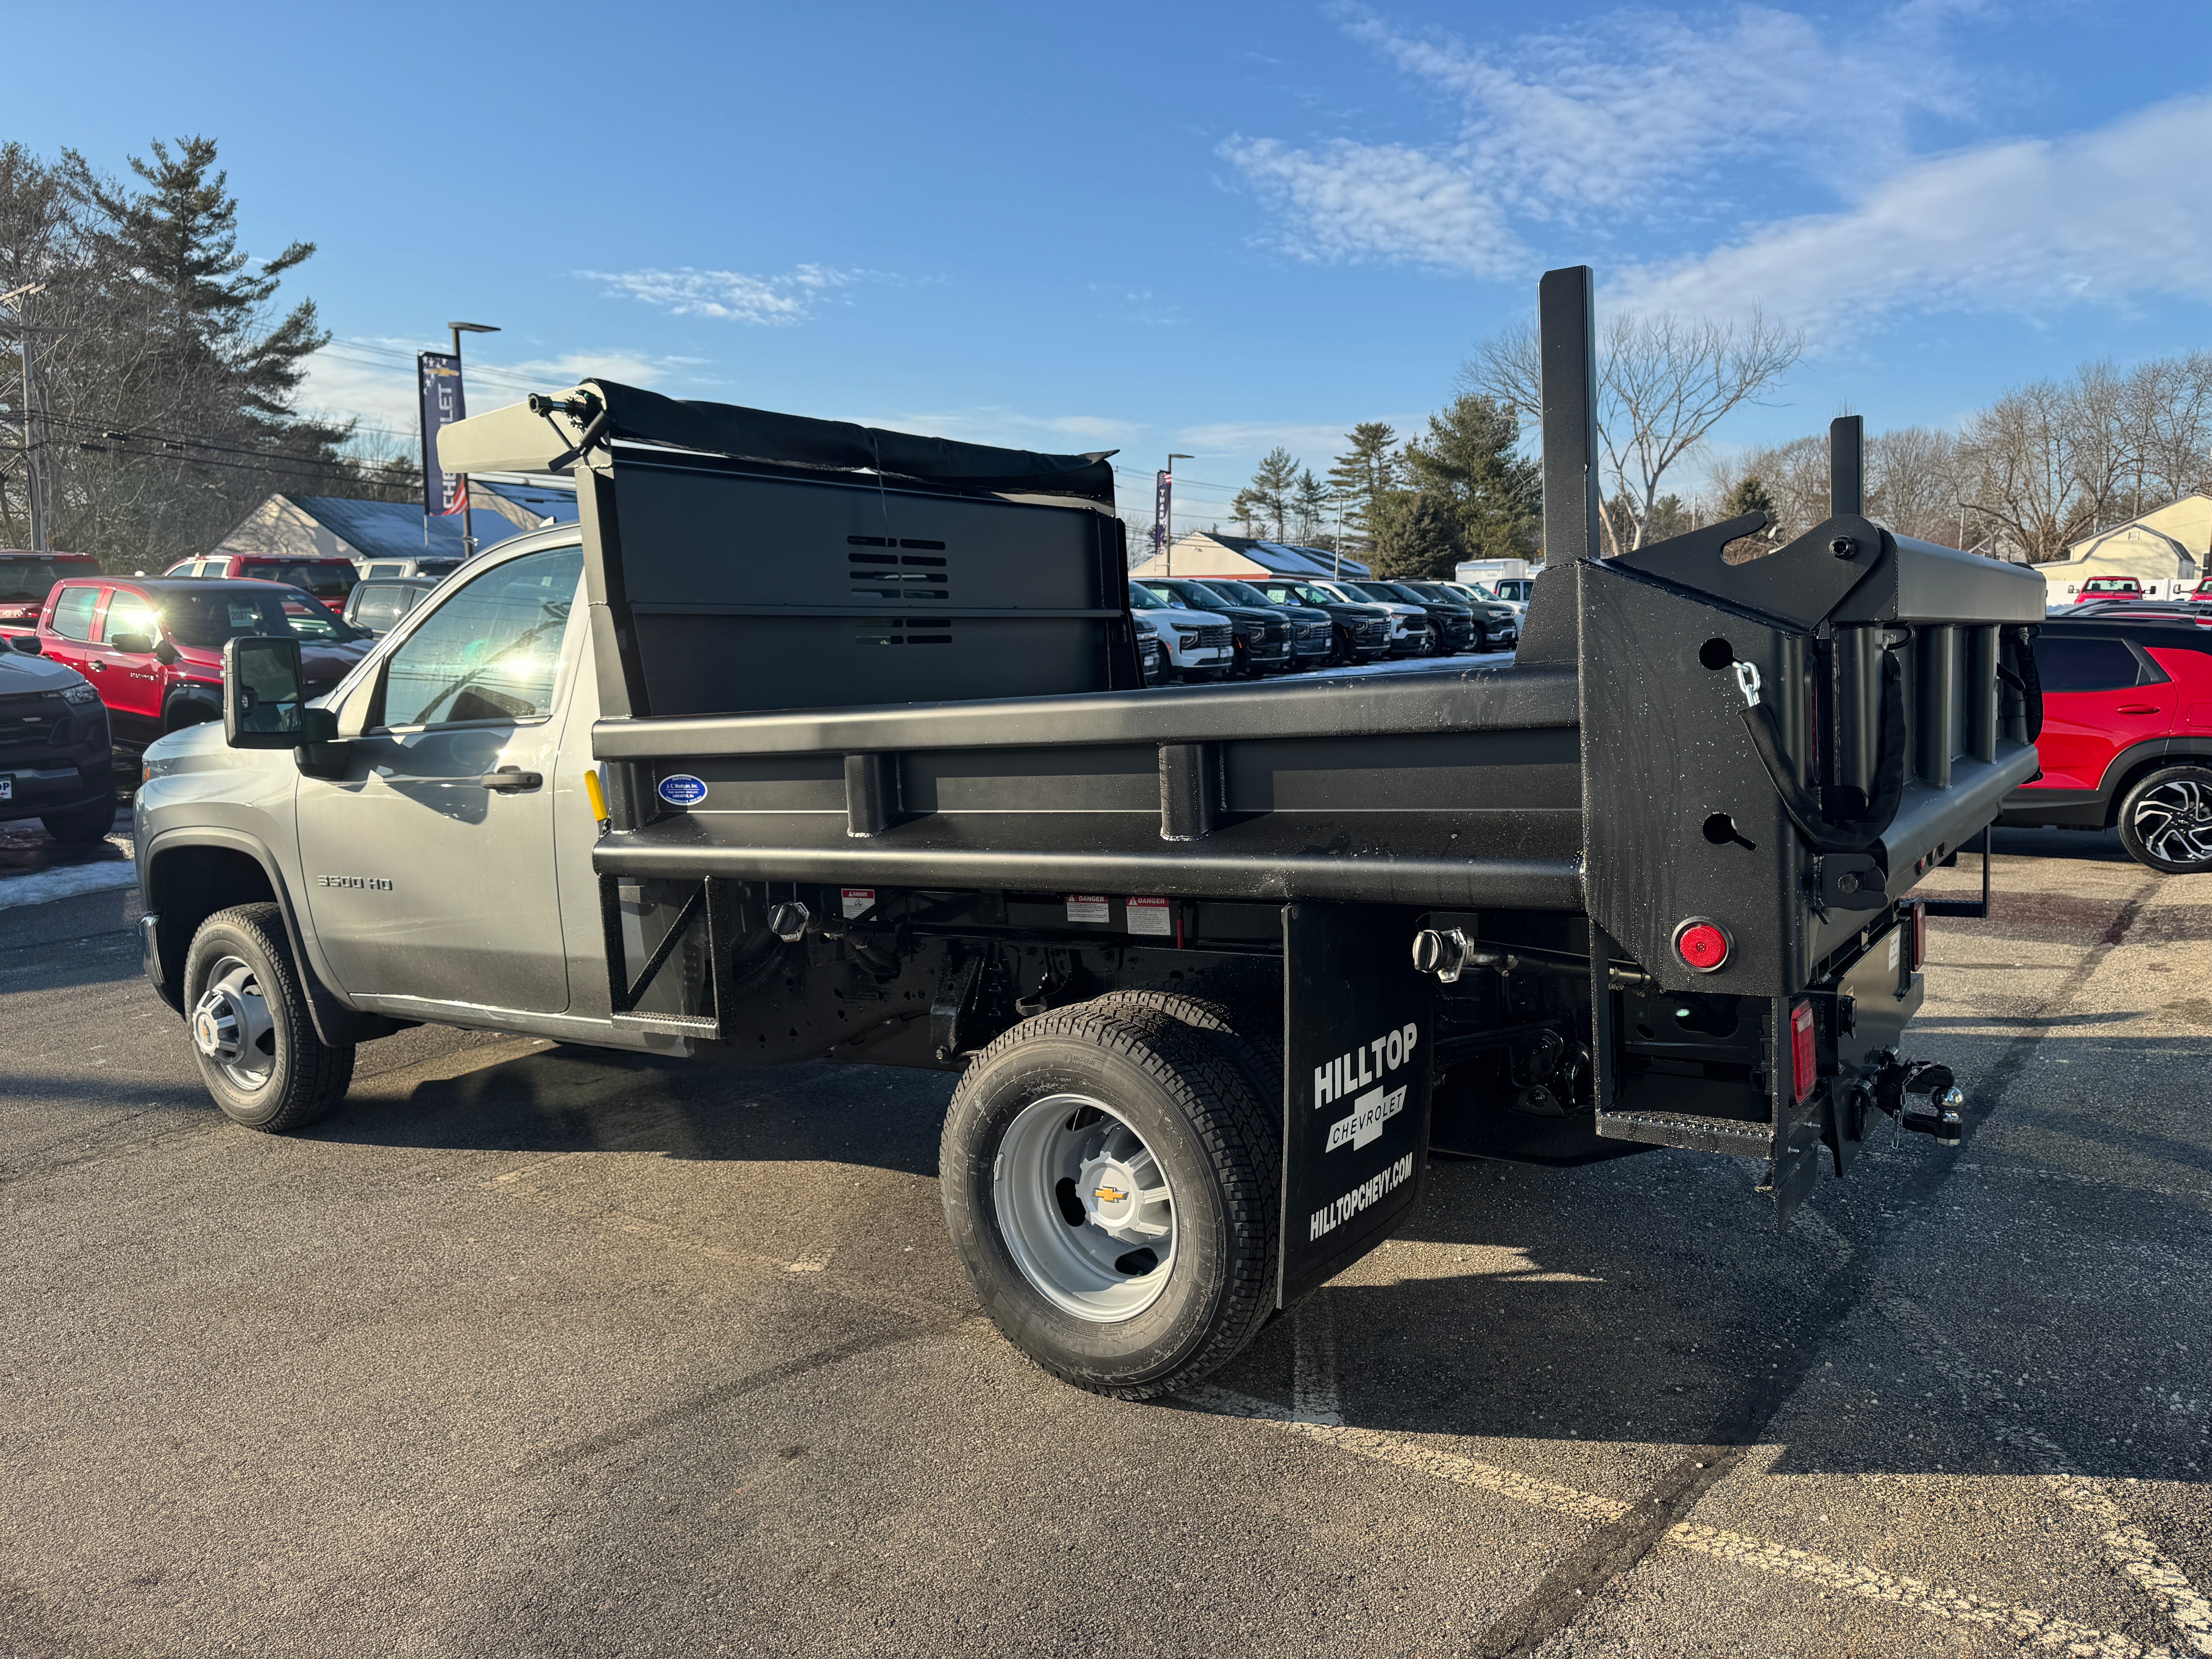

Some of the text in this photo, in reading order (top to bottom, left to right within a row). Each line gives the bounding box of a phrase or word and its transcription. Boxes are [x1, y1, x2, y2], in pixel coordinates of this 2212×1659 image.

[438, 383, 456, 509] CHELET
[318, 875, 393, 890] 3500 HD
[1315, 1023, 1417, 1109] HILLTOP
[1333, 1092, 1402, 1144] CHEVROLET
[1310, 1152, 1413, 1242] HILLTOPCHEVY.COM
